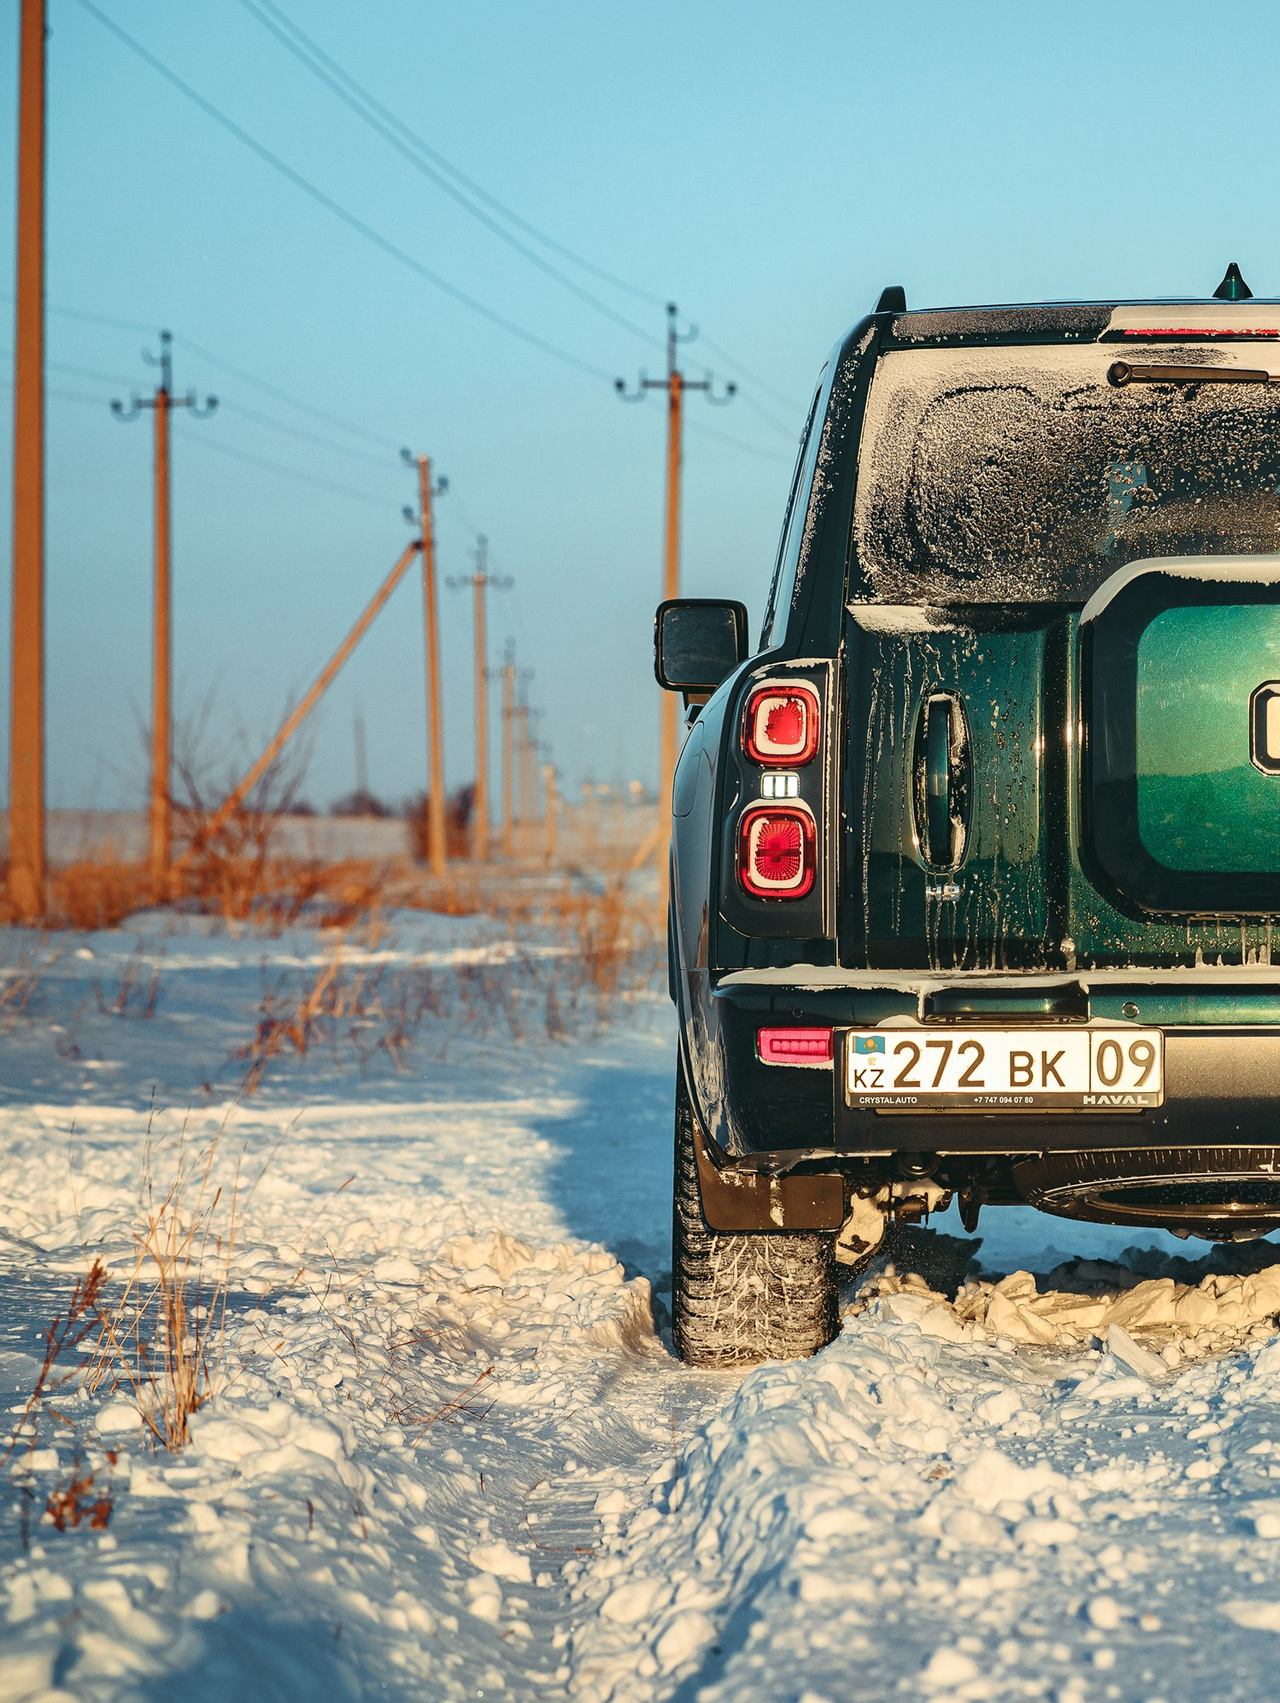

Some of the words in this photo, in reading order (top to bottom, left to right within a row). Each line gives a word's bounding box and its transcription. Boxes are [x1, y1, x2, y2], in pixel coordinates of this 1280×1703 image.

[925, 885, 960, 901] H9
[893, 1039, 986, 1088] 272
[1009, 1050, 1066, 1088] BK
[1096, 1039, 1156, 1088] 09
[853, 1069, 885, 1088] KZ
[859, 1096, 895, 1104] CRYSTAL
[895, 1096, 918, 1104] AUTO
[973, 1096, 983, 1104] +7
[985, 1096, 998, 1104] 747
[999, 1096, 1013, 1104] 094
[1014, 1096, 1023, 1104] 07
[1083, 1095, 1149, 1105] HAVAL
